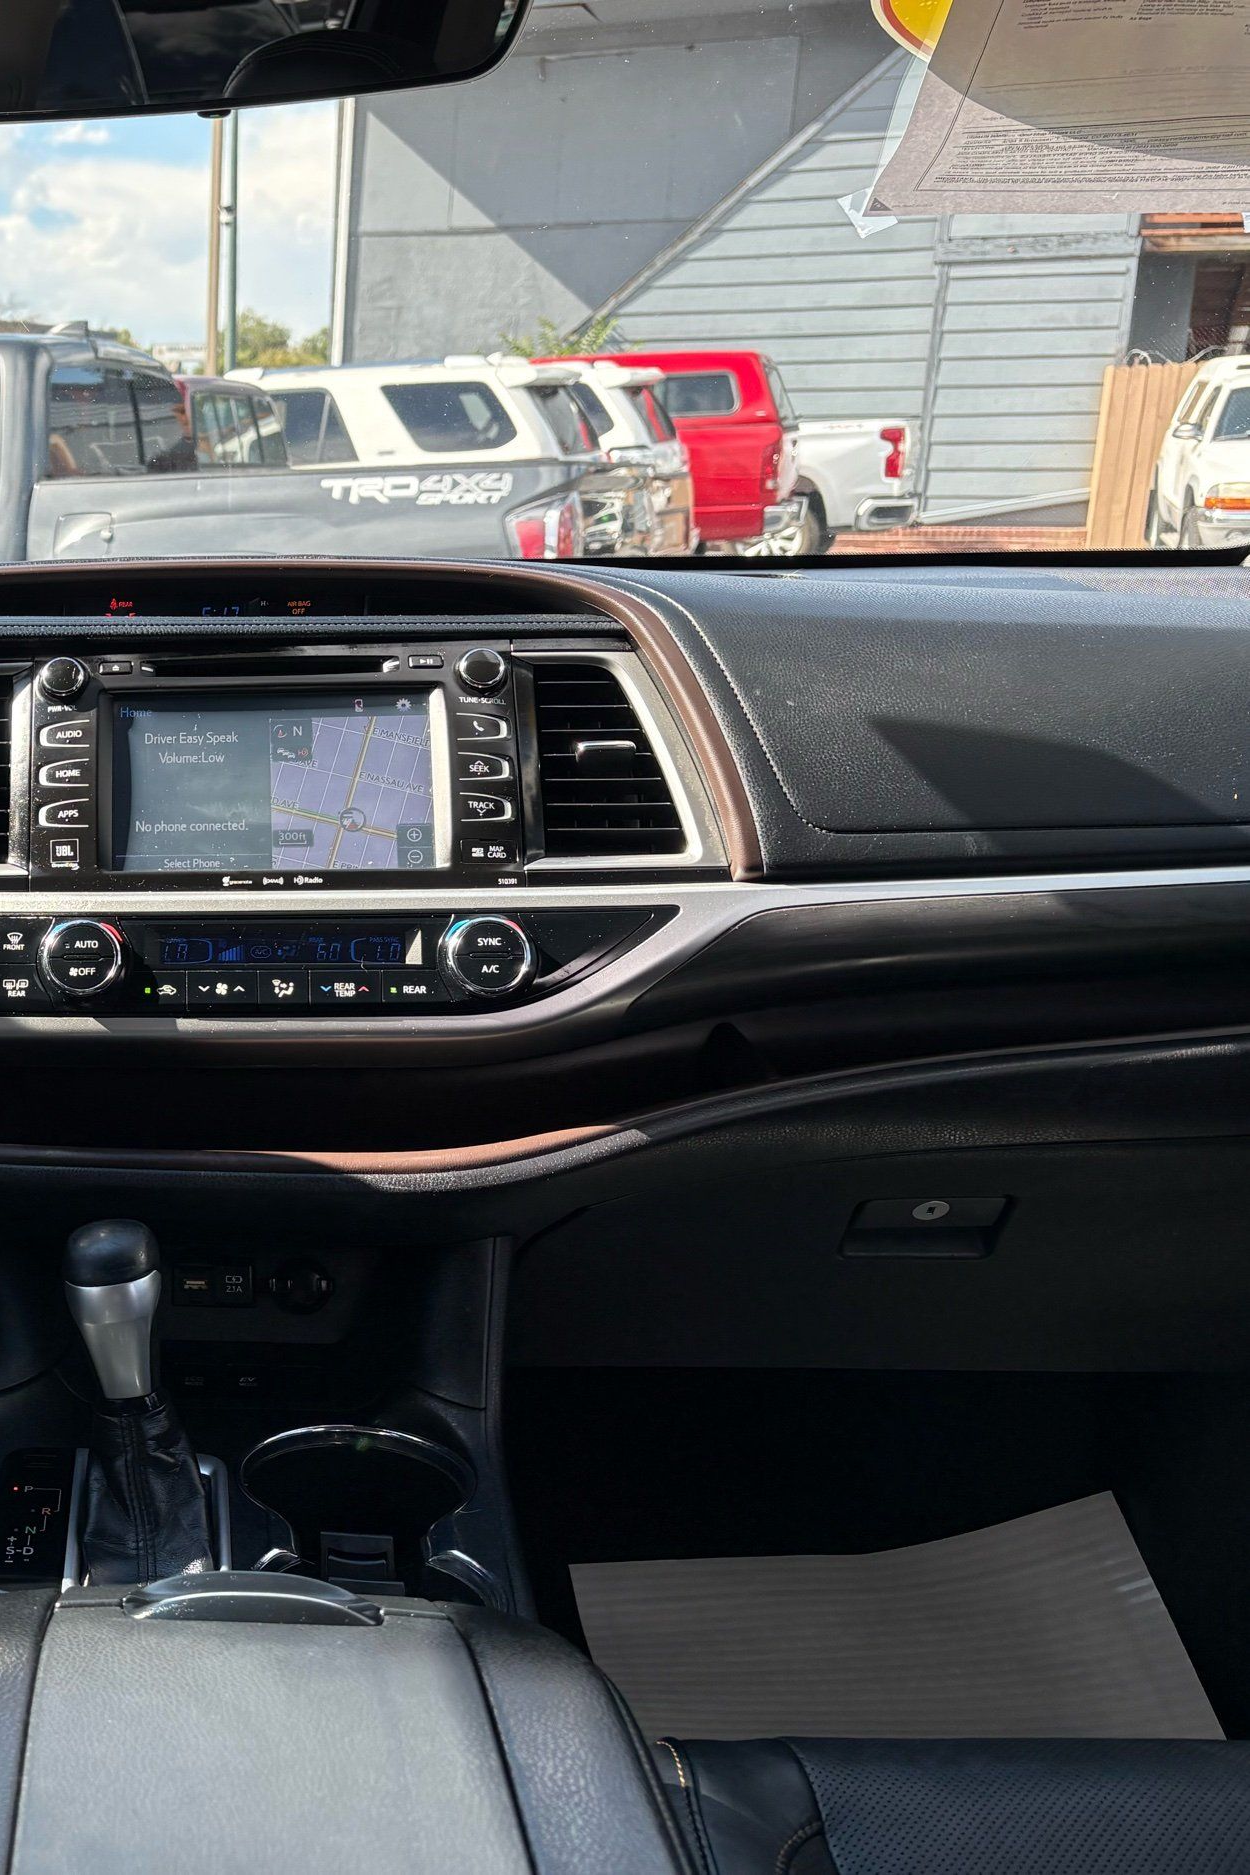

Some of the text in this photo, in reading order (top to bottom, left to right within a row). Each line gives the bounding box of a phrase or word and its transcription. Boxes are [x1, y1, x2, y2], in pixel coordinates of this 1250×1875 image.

[320, 475, 420, 504] TRD
[120, 707, 153, 718] Home
[55, 730, 83, 739] AUDIO
[292, 726, 303, 736] N
[144, 731, 239, 746] Driver Easy Speak
[158, 752, 225, 764] Volume:Low
[469, 764, 490, 773] SEEK
[55, 769, 82, 778] HOME
[366, 773, 405, 788] NASSAU
[406, 783, 424, 793] AVE
[281, 799, 300, 808] AVE
[468, 801, 495, 809] TRACK
[57, 810, 79, 818] APPS
[135, 820, 249, 834] No phone connected.
[279, 832, 307, 841] 300ft
[55, 845, 74, 857] JBL
[487, 851, 507, 859] CARD
[163, 858, 221, 868] Select Phone
[304, 876, 324, 884] Radio
[74, 940, 99, 949] AUTO
[477, 937, 502, 946] SYNC
[78, 968, 97, 976] OFF
[481, 965, 500, 973] A/C
[334, 982, 355, 990] REAR
[402, 985, 427, 994] REAR
[334, 990, 356, 998] TEMP
[24, 1485, 34, 1493] P
[41, 1507, 51, 1515] R
[24, 1525, 37, 1534] N
